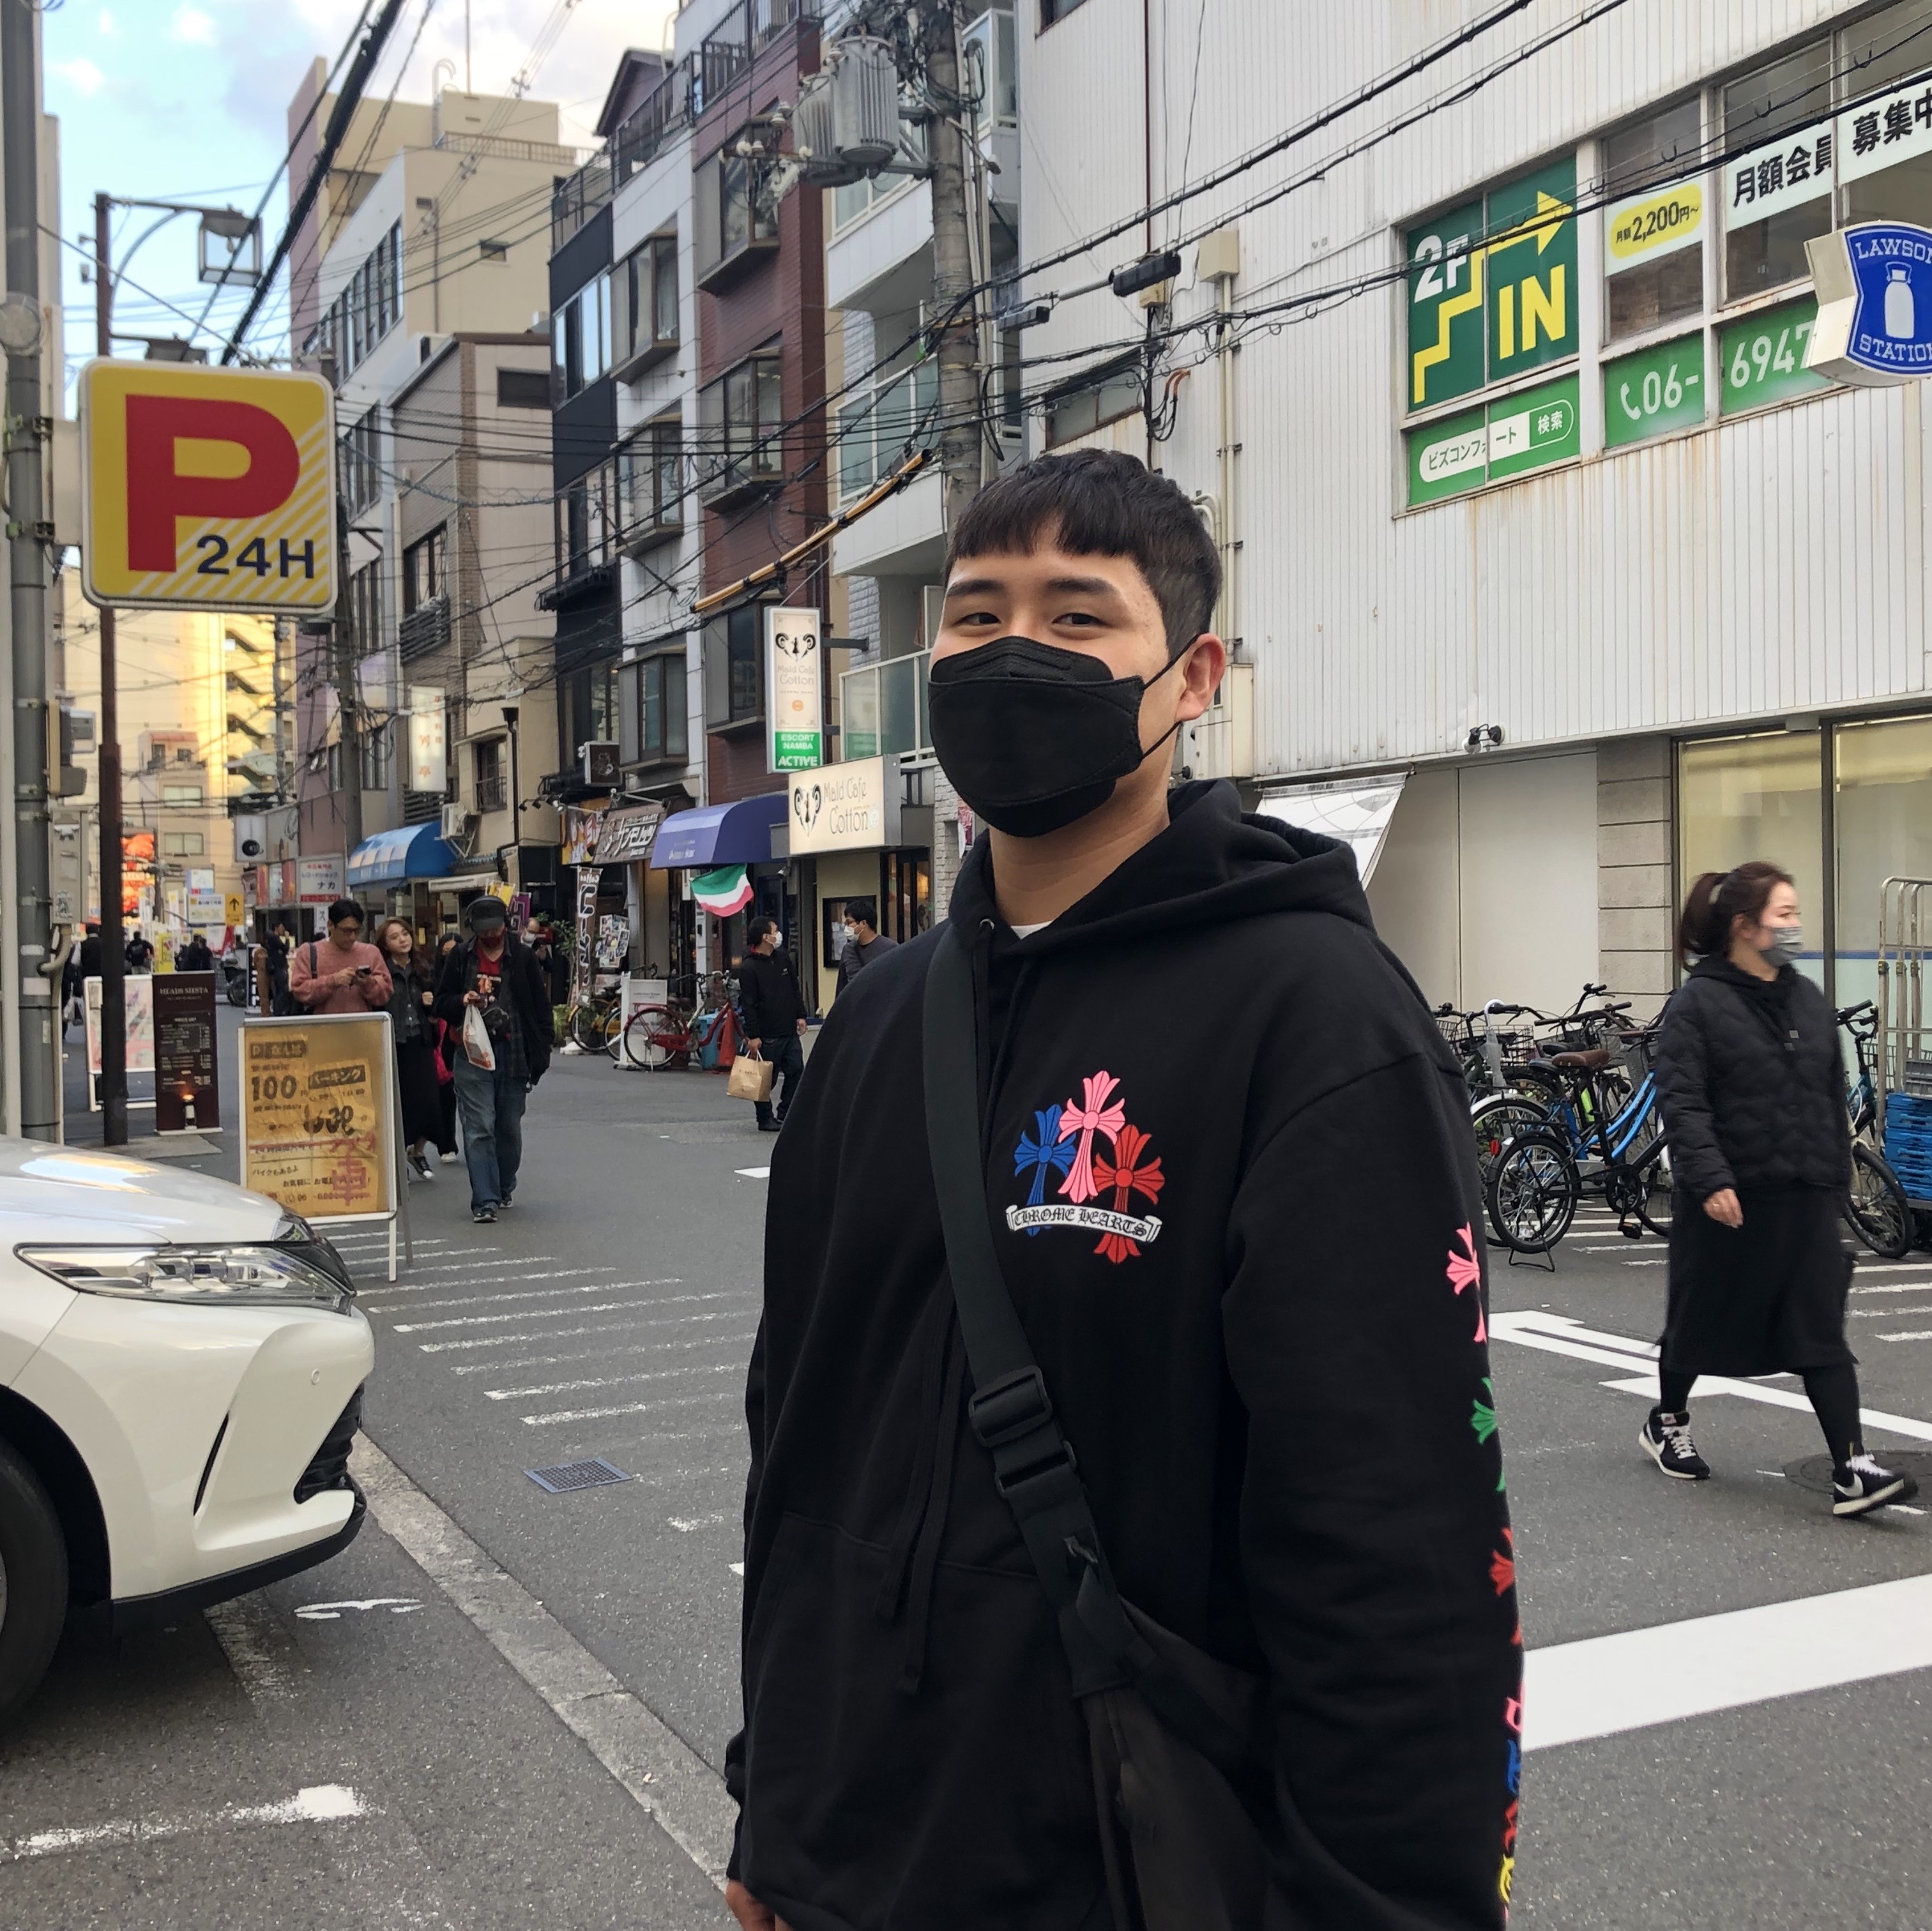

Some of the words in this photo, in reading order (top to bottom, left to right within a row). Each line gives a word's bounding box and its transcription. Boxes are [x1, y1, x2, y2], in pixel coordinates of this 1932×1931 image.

[1733, 133, 1832, 208] 月額会員
[1413, 232, 1469, 304] 2F
[1498, 263, 1565, 361] IN
[1537, 410, 1563, 436] 検索
[125, 393, 301, 573] P
[196, 534, 315, 579] 24H
[779, 674, 814, 685] Cotton
[780, 734, 815, 742] ESCORT
[783, 742, 814, 750] NAMBA
[778, 755, 818, 767] ACTIVE
[846, 776, 867, 803] Cafe
[829, 805, 868, 835] Cotton
[252, 1075, 297, 1102] 100
[310, 1068, 362, 1087] パーキング
[1014, 1208, 1076, 1226] CHROME
[1079, 1208, 1148, 1237] HEARTS
